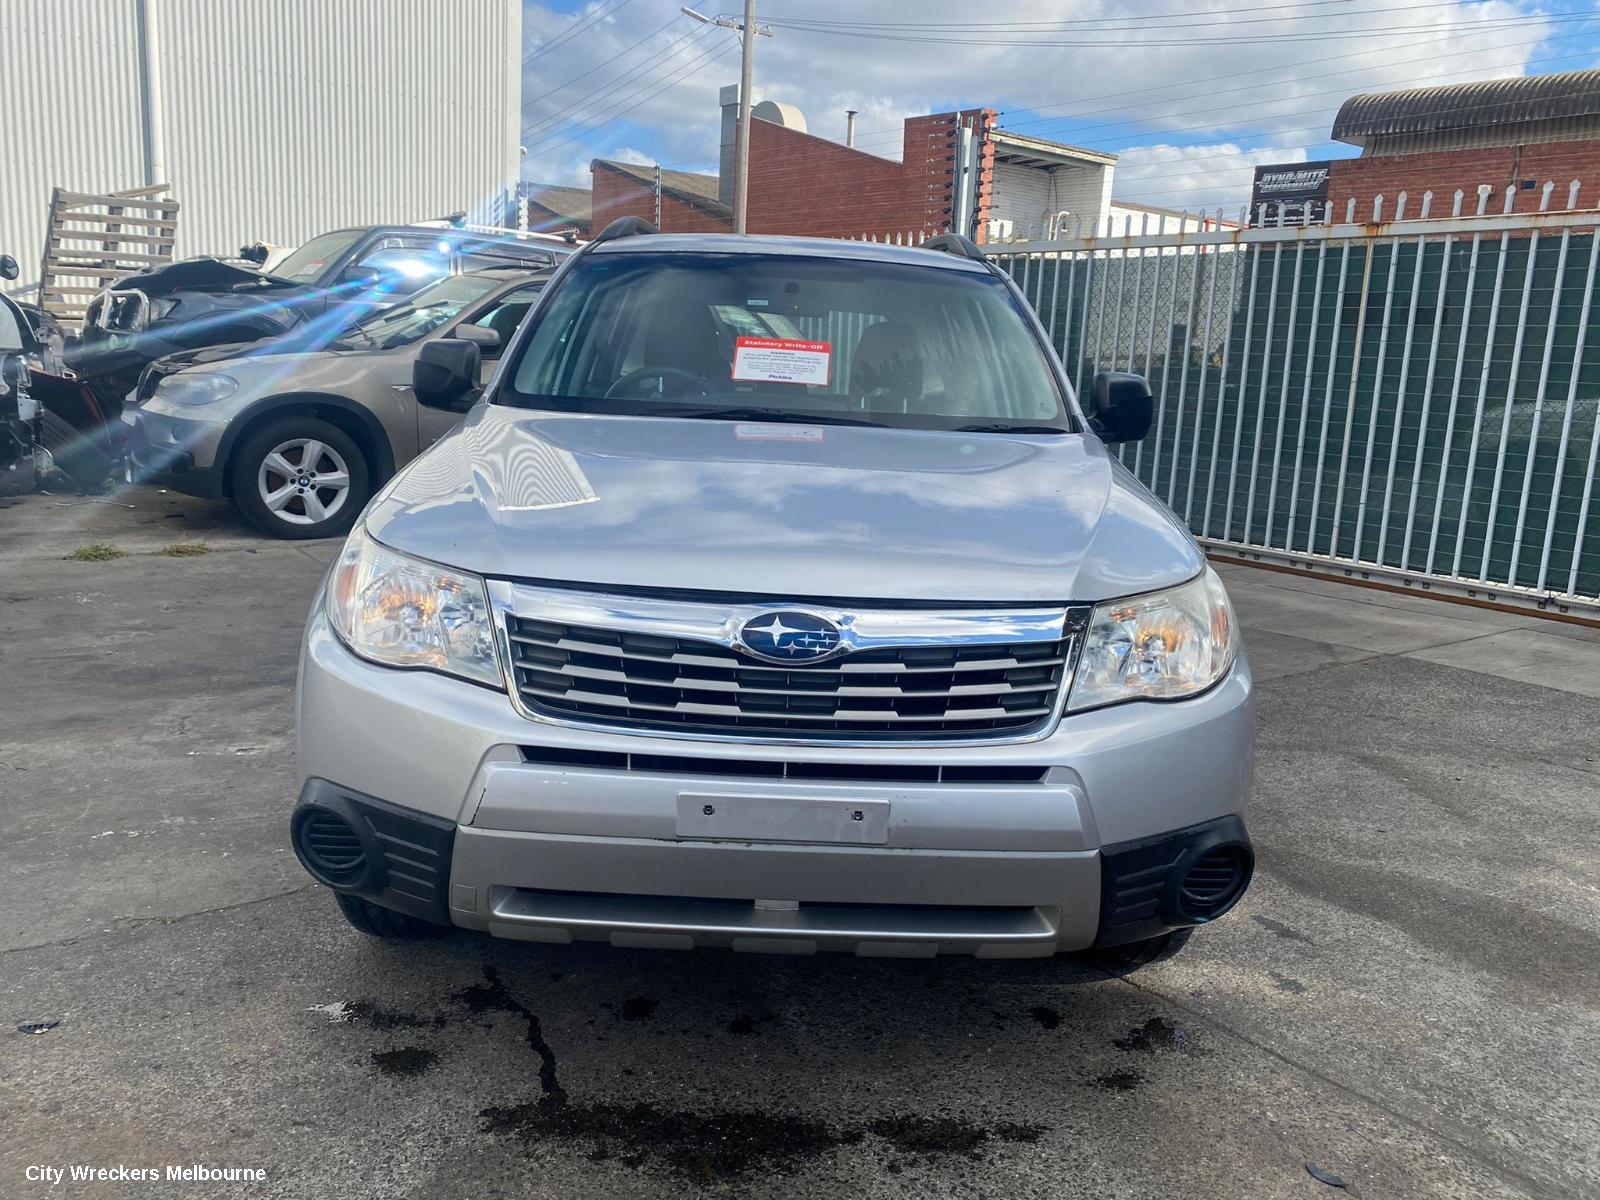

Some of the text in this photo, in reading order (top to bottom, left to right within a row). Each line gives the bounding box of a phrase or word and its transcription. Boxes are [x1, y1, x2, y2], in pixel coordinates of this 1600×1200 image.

[1261, 169, 1327, 185] DYNO-MITE
[1261, 181, 1319, 192] PERFORMANCE
[744, 340, 783, 348] Statutory
